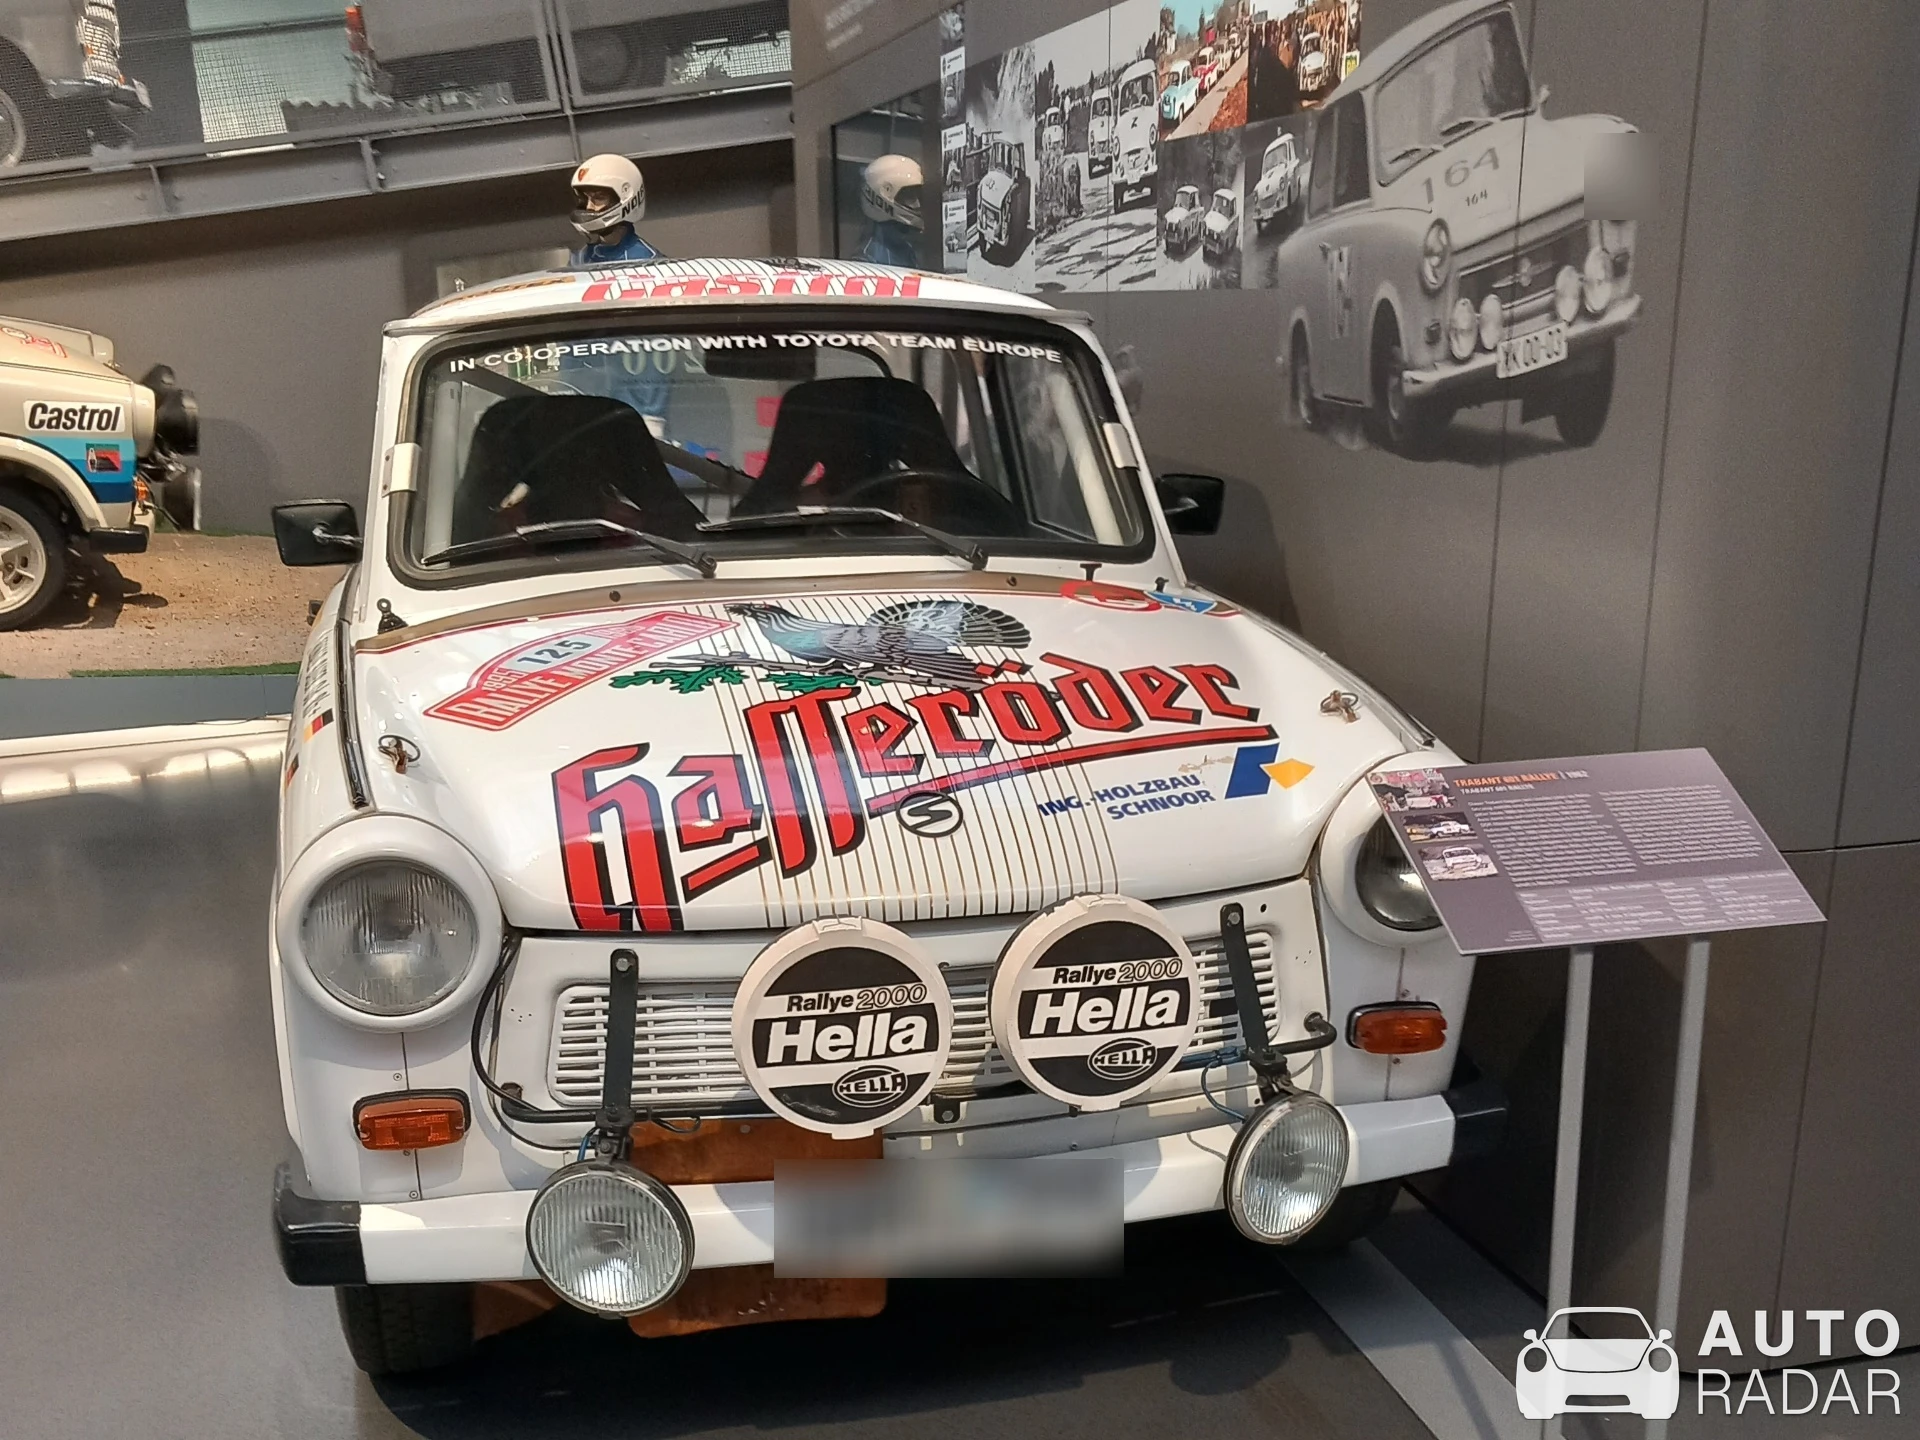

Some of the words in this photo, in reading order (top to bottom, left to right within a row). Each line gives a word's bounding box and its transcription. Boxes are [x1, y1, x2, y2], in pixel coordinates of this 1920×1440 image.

[1421, 147, 1500, 204] 164
[582, 272, 922, 302] Castrol
[450, 358, 475, 373] IN
[697, 334, 767, 350] WITH
[772, 332, 880, 348] TOYOTA
[885, 333, 957, 350] TEAM
[963, 335, 1062, 363] EUROPE
[28, 403, 121, 431] Castrol
[517, 639, 593, 666] 125
[445, 674, 572, 723] RALLYE
[1453, 776, 1502, 788] TRABANT
[1460, 785, 1495, 795] TRABANT
[1107, 790, 1216, 821] SCHNOOR
[1053, 965, 1117, 985] Rallye
[1117, 958, 1183, 983] 2000
[787, 993, 854, 1013] Rallye
[855, 983, 927, 1010] 2000
[1029, 985, 1181, 1035] Hella
[766, 1012, 928, 1064] Hella
[1094, 1045, 1157, 1066] HELLA
[838, 1073, 906, 1093] HELLA
